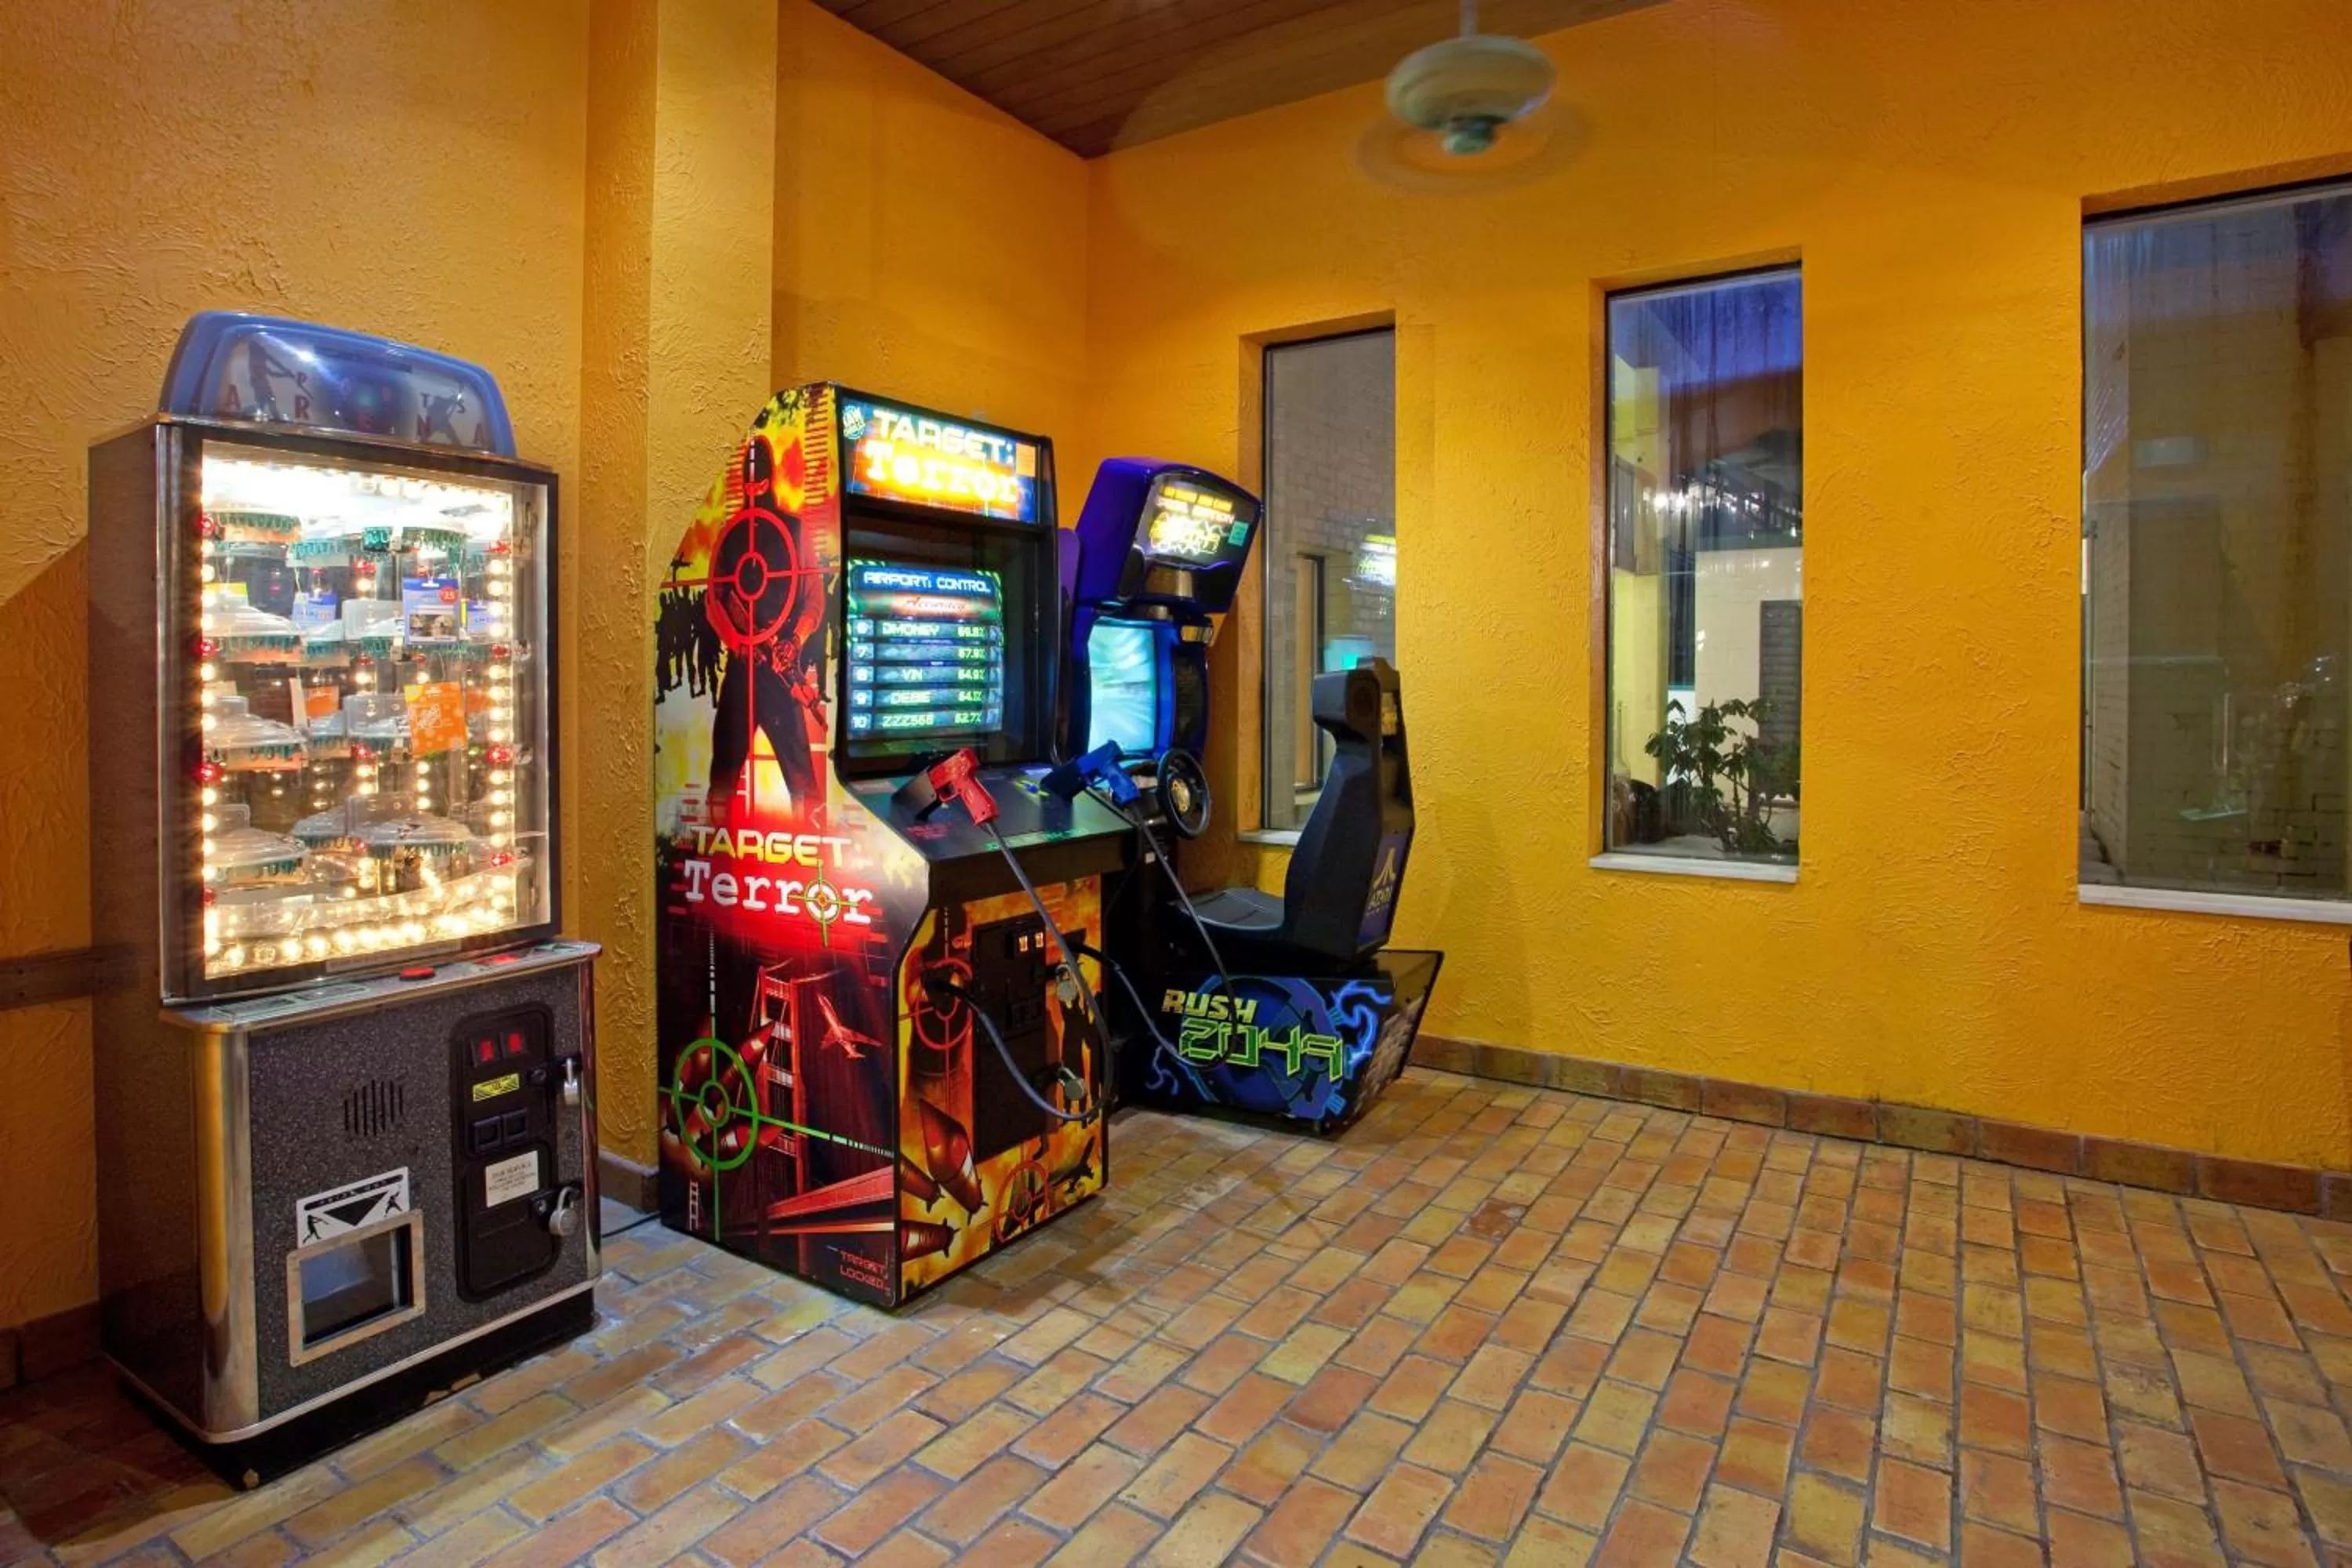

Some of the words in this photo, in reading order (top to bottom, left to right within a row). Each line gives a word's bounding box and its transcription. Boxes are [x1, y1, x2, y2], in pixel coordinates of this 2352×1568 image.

[936, 578, 992, 593] CONTROL
[857, 645, 869, 659] 7
[902, 669, 923, 681] VIN
[853, 715, 868, 728] 10
[684, 858, 873, 924] Terror
[1161, 988, 1258, 1024] RUSH
[1178, 1017, 1344, 1083] 2049
